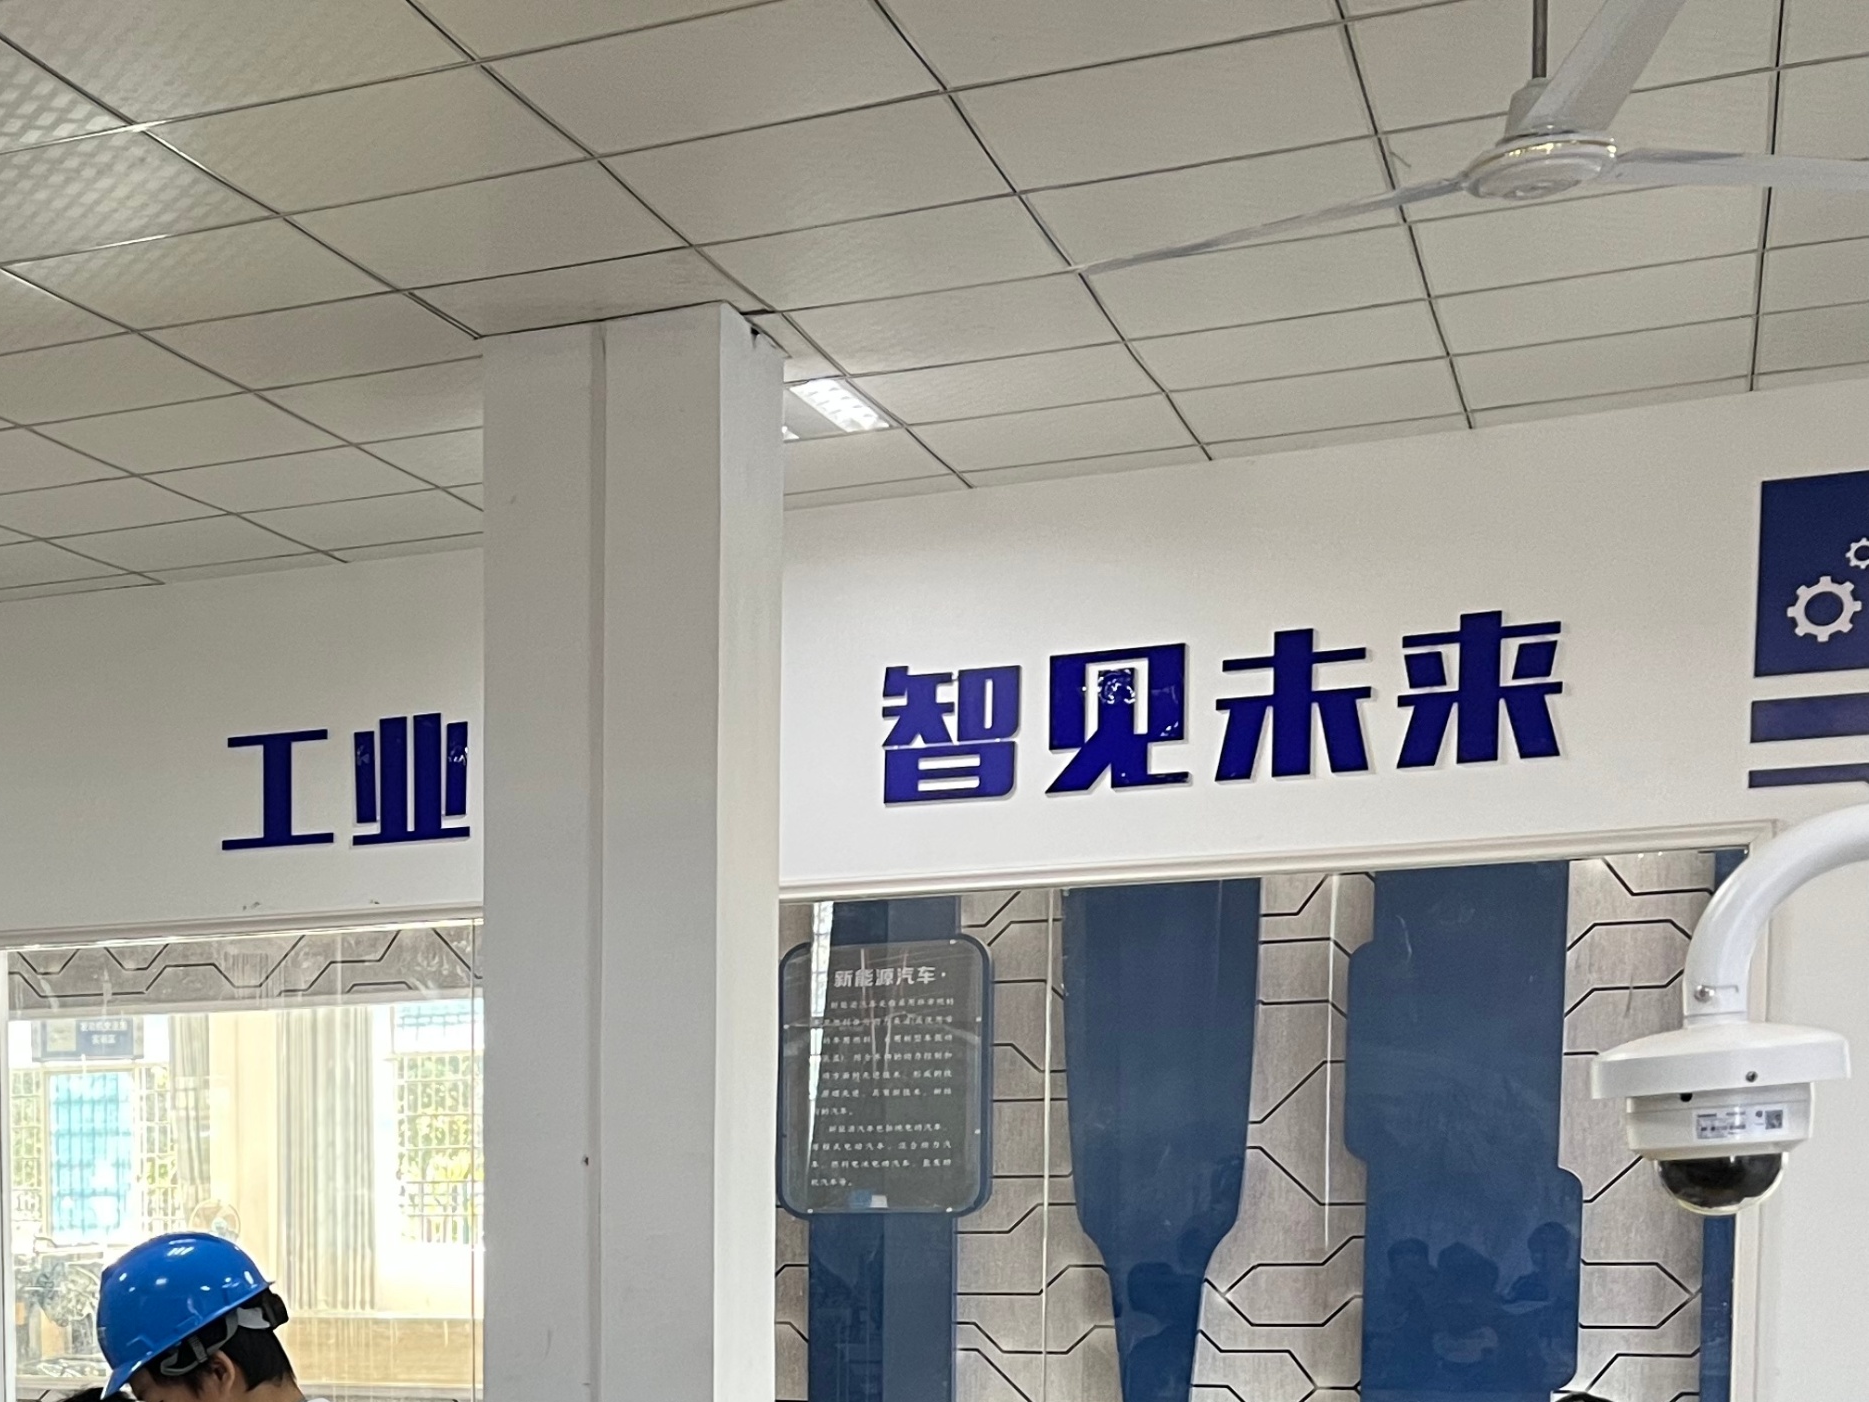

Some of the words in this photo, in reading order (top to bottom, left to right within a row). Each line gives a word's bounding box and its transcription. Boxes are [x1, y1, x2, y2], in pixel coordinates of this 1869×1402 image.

[882, 610, 1563, 805] 智见未来
[222, 712, 471, 850] 工业
[833, 966, 936, 988] 新能源汽车
